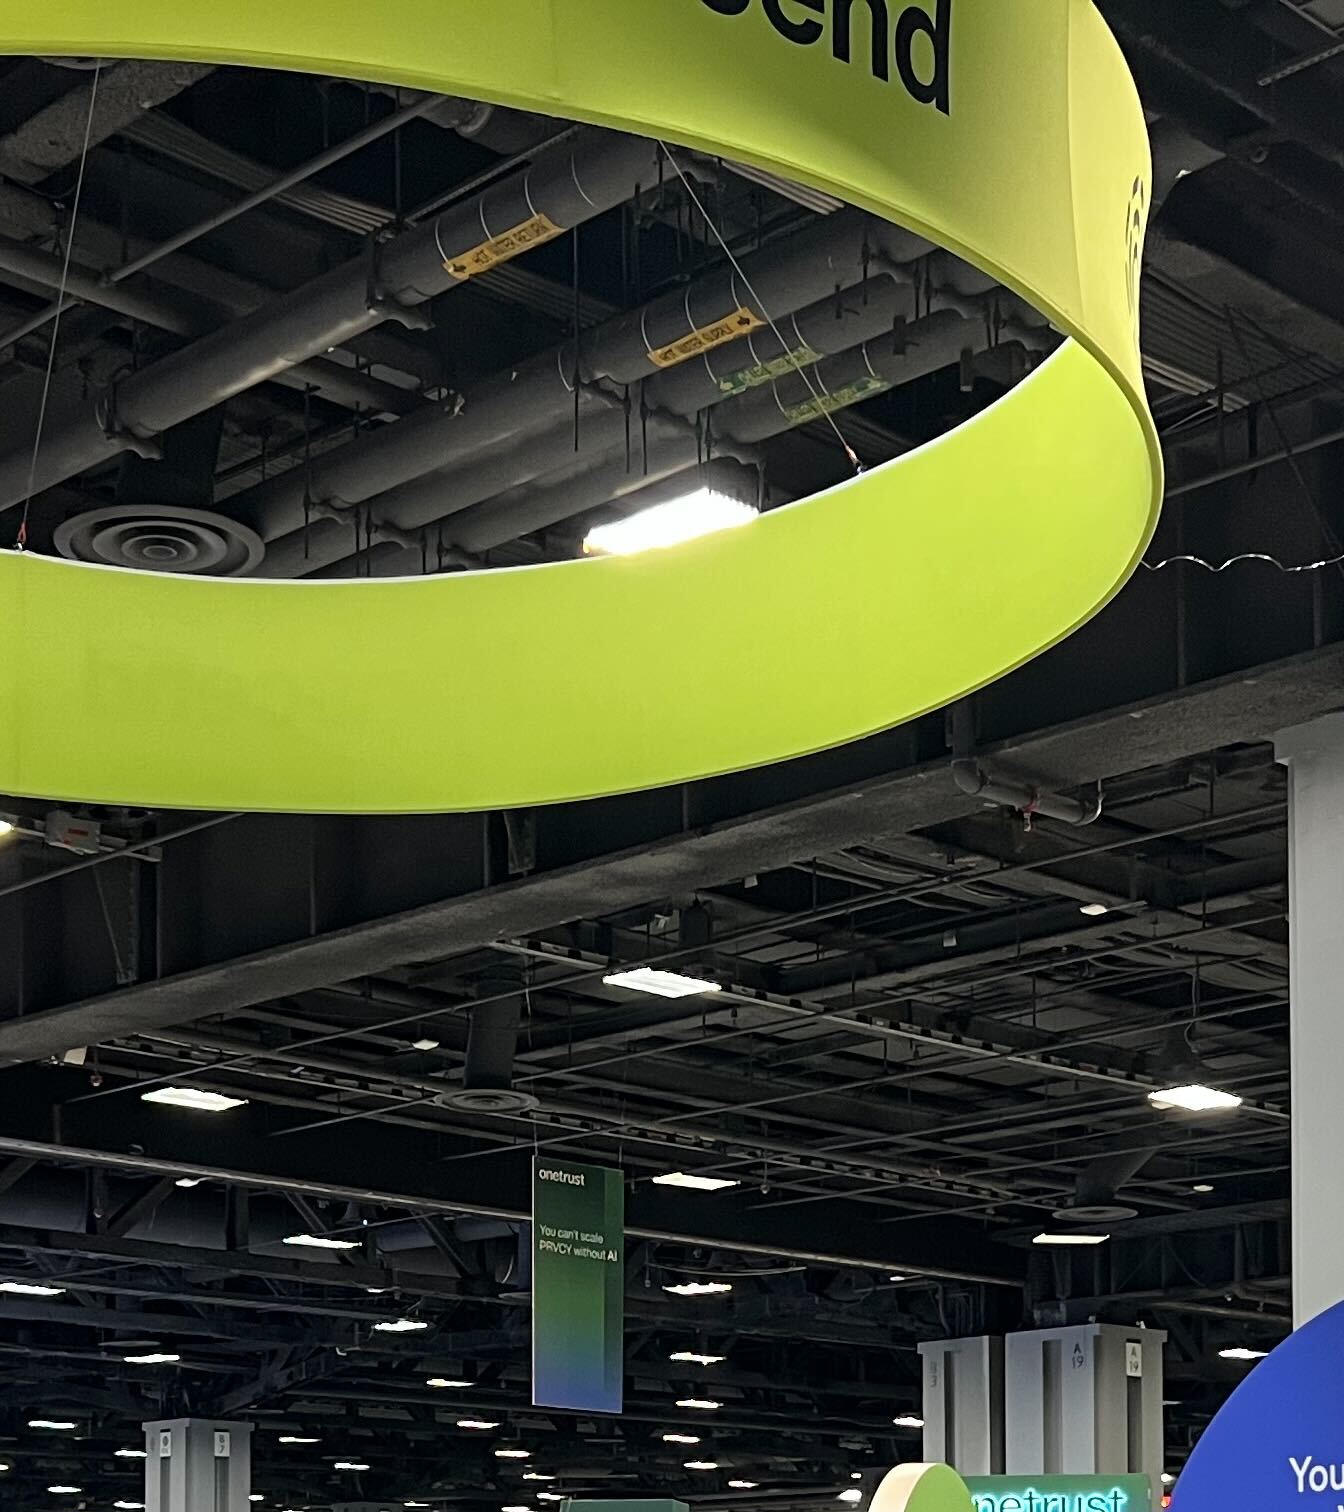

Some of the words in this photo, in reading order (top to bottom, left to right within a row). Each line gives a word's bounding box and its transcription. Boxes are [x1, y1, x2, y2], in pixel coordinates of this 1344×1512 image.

[538, 1168, 585, 1186] onetrust
[539, 1223, 557, 1237] You
[557, 1229, 579, 1241] can't
[580, 1232, 604, 1244] scale
[539, 1239, 572, 1256] PRVCY
[573, 1245, 606, 1261] without
[607, 1249, 618, 1262] AI
[1073, 1343, 1083, 1355] A
[1071, 1355, 1085, 1369] 19
